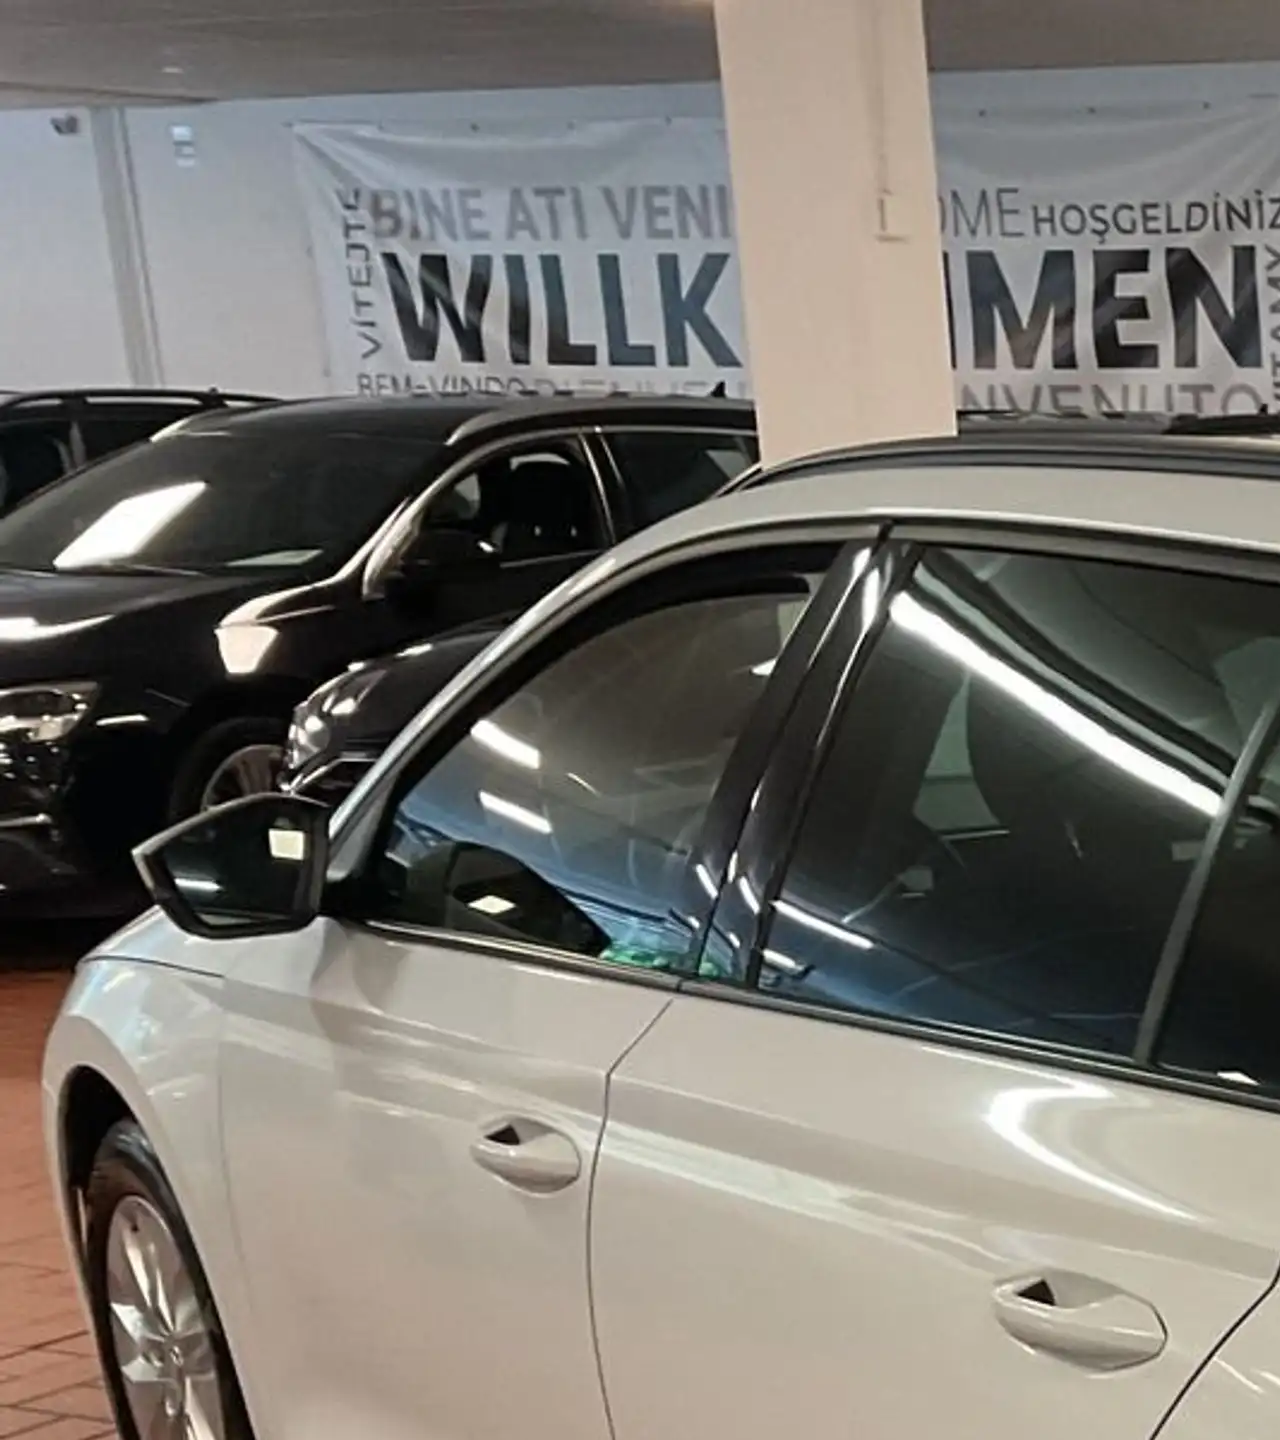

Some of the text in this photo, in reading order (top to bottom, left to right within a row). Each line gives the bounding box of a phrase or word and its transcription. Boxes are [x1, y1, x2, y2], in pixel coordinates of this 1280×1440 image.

[374, 187, 491, 242] BINE
[604, 185, 732, 240] VENI
[379, 245, 1264, 370] WILLKMEN
